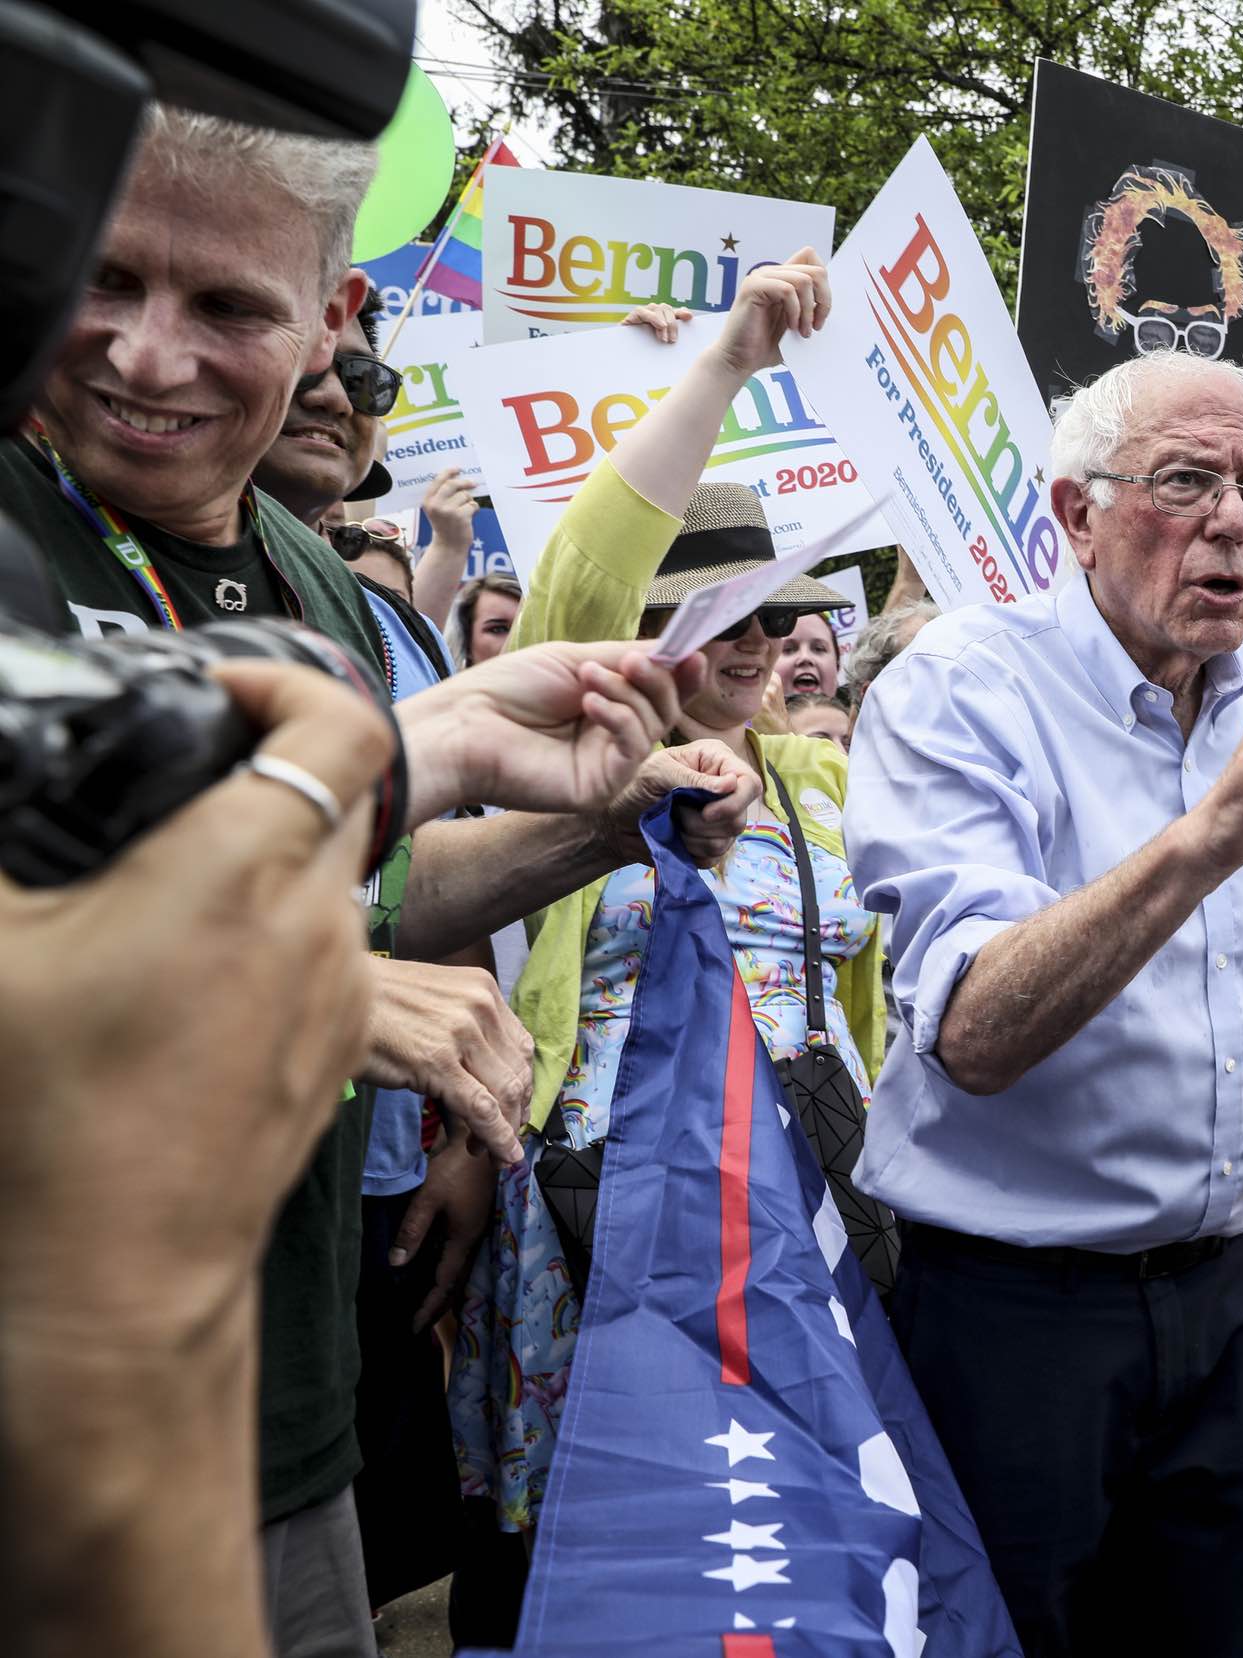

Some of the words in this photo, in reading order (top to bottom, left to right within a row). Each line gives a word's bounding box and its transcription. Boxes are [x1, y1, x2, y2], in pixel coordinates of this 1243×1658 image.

[506, 215, 783, 312] Berni
[501, 370, 827, 477] Beni
[865, 344, 901, 403] For
[879, 211, 1059, 591] Bernie
[385, 434, 467, 462] resident
[776, 459, 859, 496] 2020
[898, 399, 973, 541] President
[893, 465, 963, 593] BernieSanders.com
